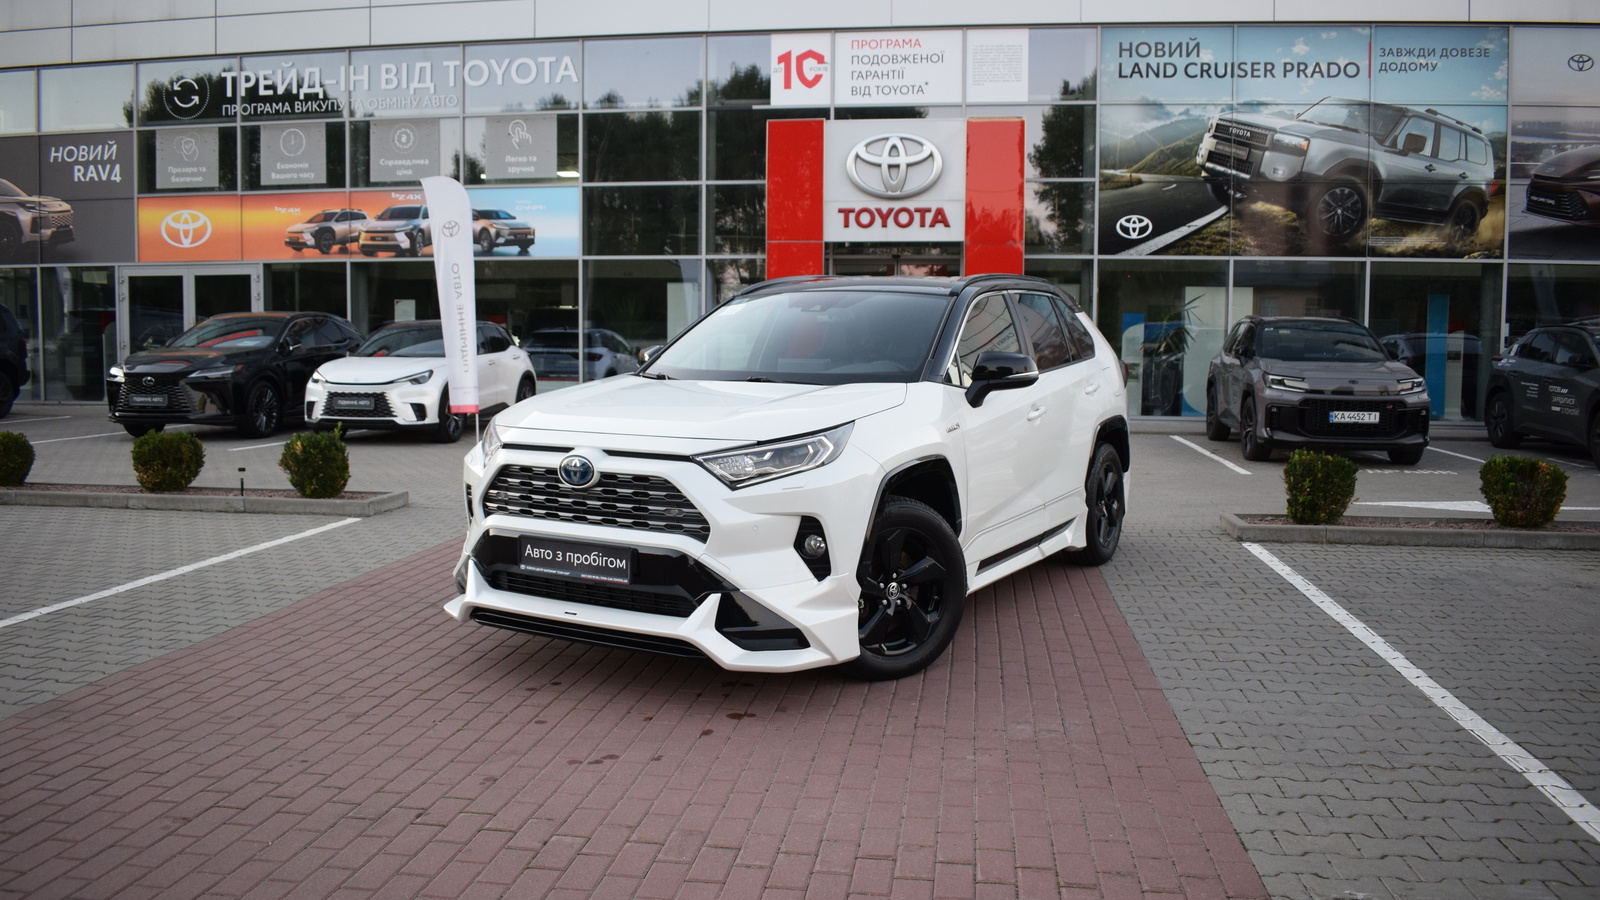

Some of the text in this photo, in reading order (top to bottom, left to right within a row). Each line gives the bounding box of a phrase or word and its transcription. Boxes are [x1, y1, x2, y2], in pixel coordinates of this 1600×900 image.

[851, 38, 922, 50] ПРОГРАМА
[1118, 37, 1200, 58] НОВИЙ
[851, 50, 945, 66] ПОДОВЖЕНОЇ
[1379, 47, 1490, 59] ЗАВЖДИ ДОВЕЗЕ
[1118, 61, 1361, 79] LAND CRUISER PRADO
[1379, 61, 1438, 73] ДОДОМУ
[221, 56, 579, 100] ТРЕЙД-ІН ВІД TOYOTA
[851, 67, 906, 81] ГАРАНТІЇ
[851, 85, 872, 97] ВІД
[222, 102, 292, 116] ПРОГРАМА
[294, 99, 346, 113] ВИКУПУ
[367, 96, 419, 110] ОБМІНУ
[423, 94, 458, 108] АВТО
[1229, 128, 1251, 137] TOYOTA
[50, 140, 118, 163] НОВИЙ
[380, 158, 430, 166] Справедлива
[505, 155, 527, 163] Легко
[74, 164, 122, 183] RAV4
[168, 166, 198, 174] Прозоро
[271, 172, 315, 180] Вашого часу
[396, 168, 413, 176] ціна
[507, 166, 535, 174] зручно
[171, 175, 203, 183] безпечно
[838, 207, 951, 229] TOYOTA
[1348, 413, 1366, 421] 4452
[524, 544, 626, 569] Авто з пробігом
